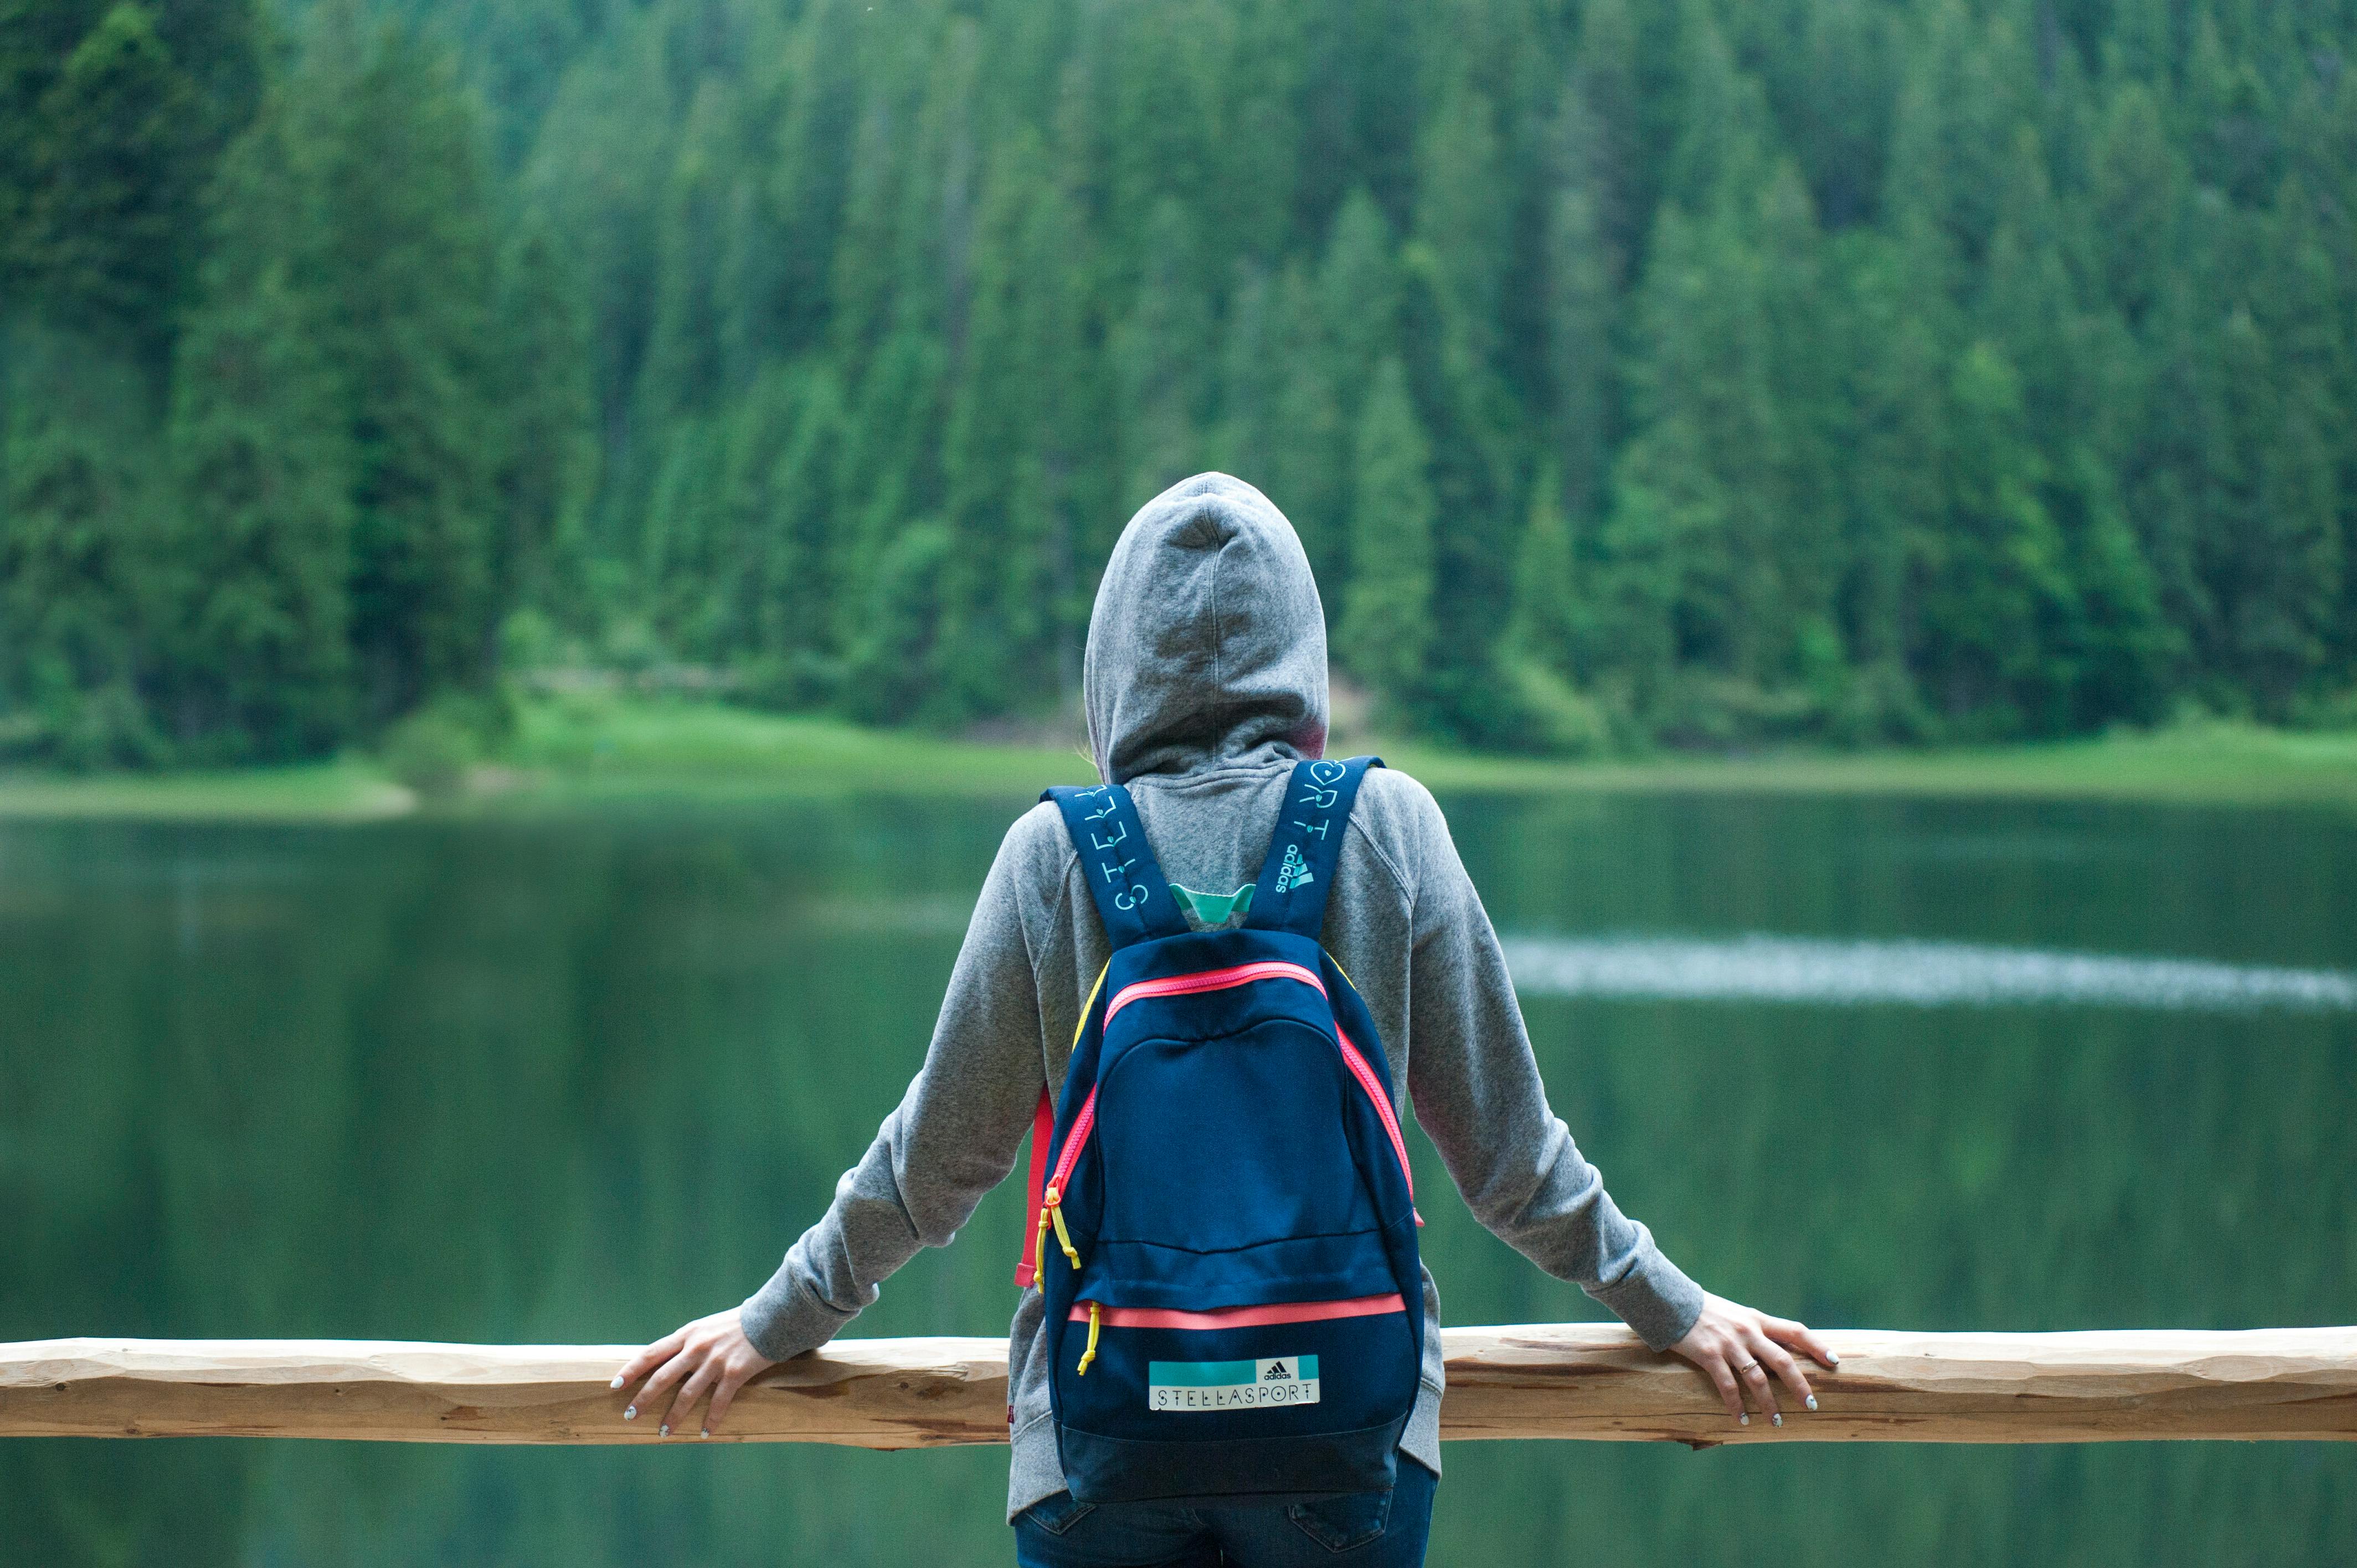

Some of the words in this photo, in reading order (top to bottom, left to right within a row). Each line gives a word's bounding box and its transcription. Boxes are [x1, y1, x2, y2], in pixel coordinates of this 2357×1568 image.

[1293, 757, 1347, 840] ORT
[1275, 844, 1299, 894] adidas
[1264, 1372, 1291, 1380] adidas
[1158, 1384, 1311, 1406] STELLASPORT
